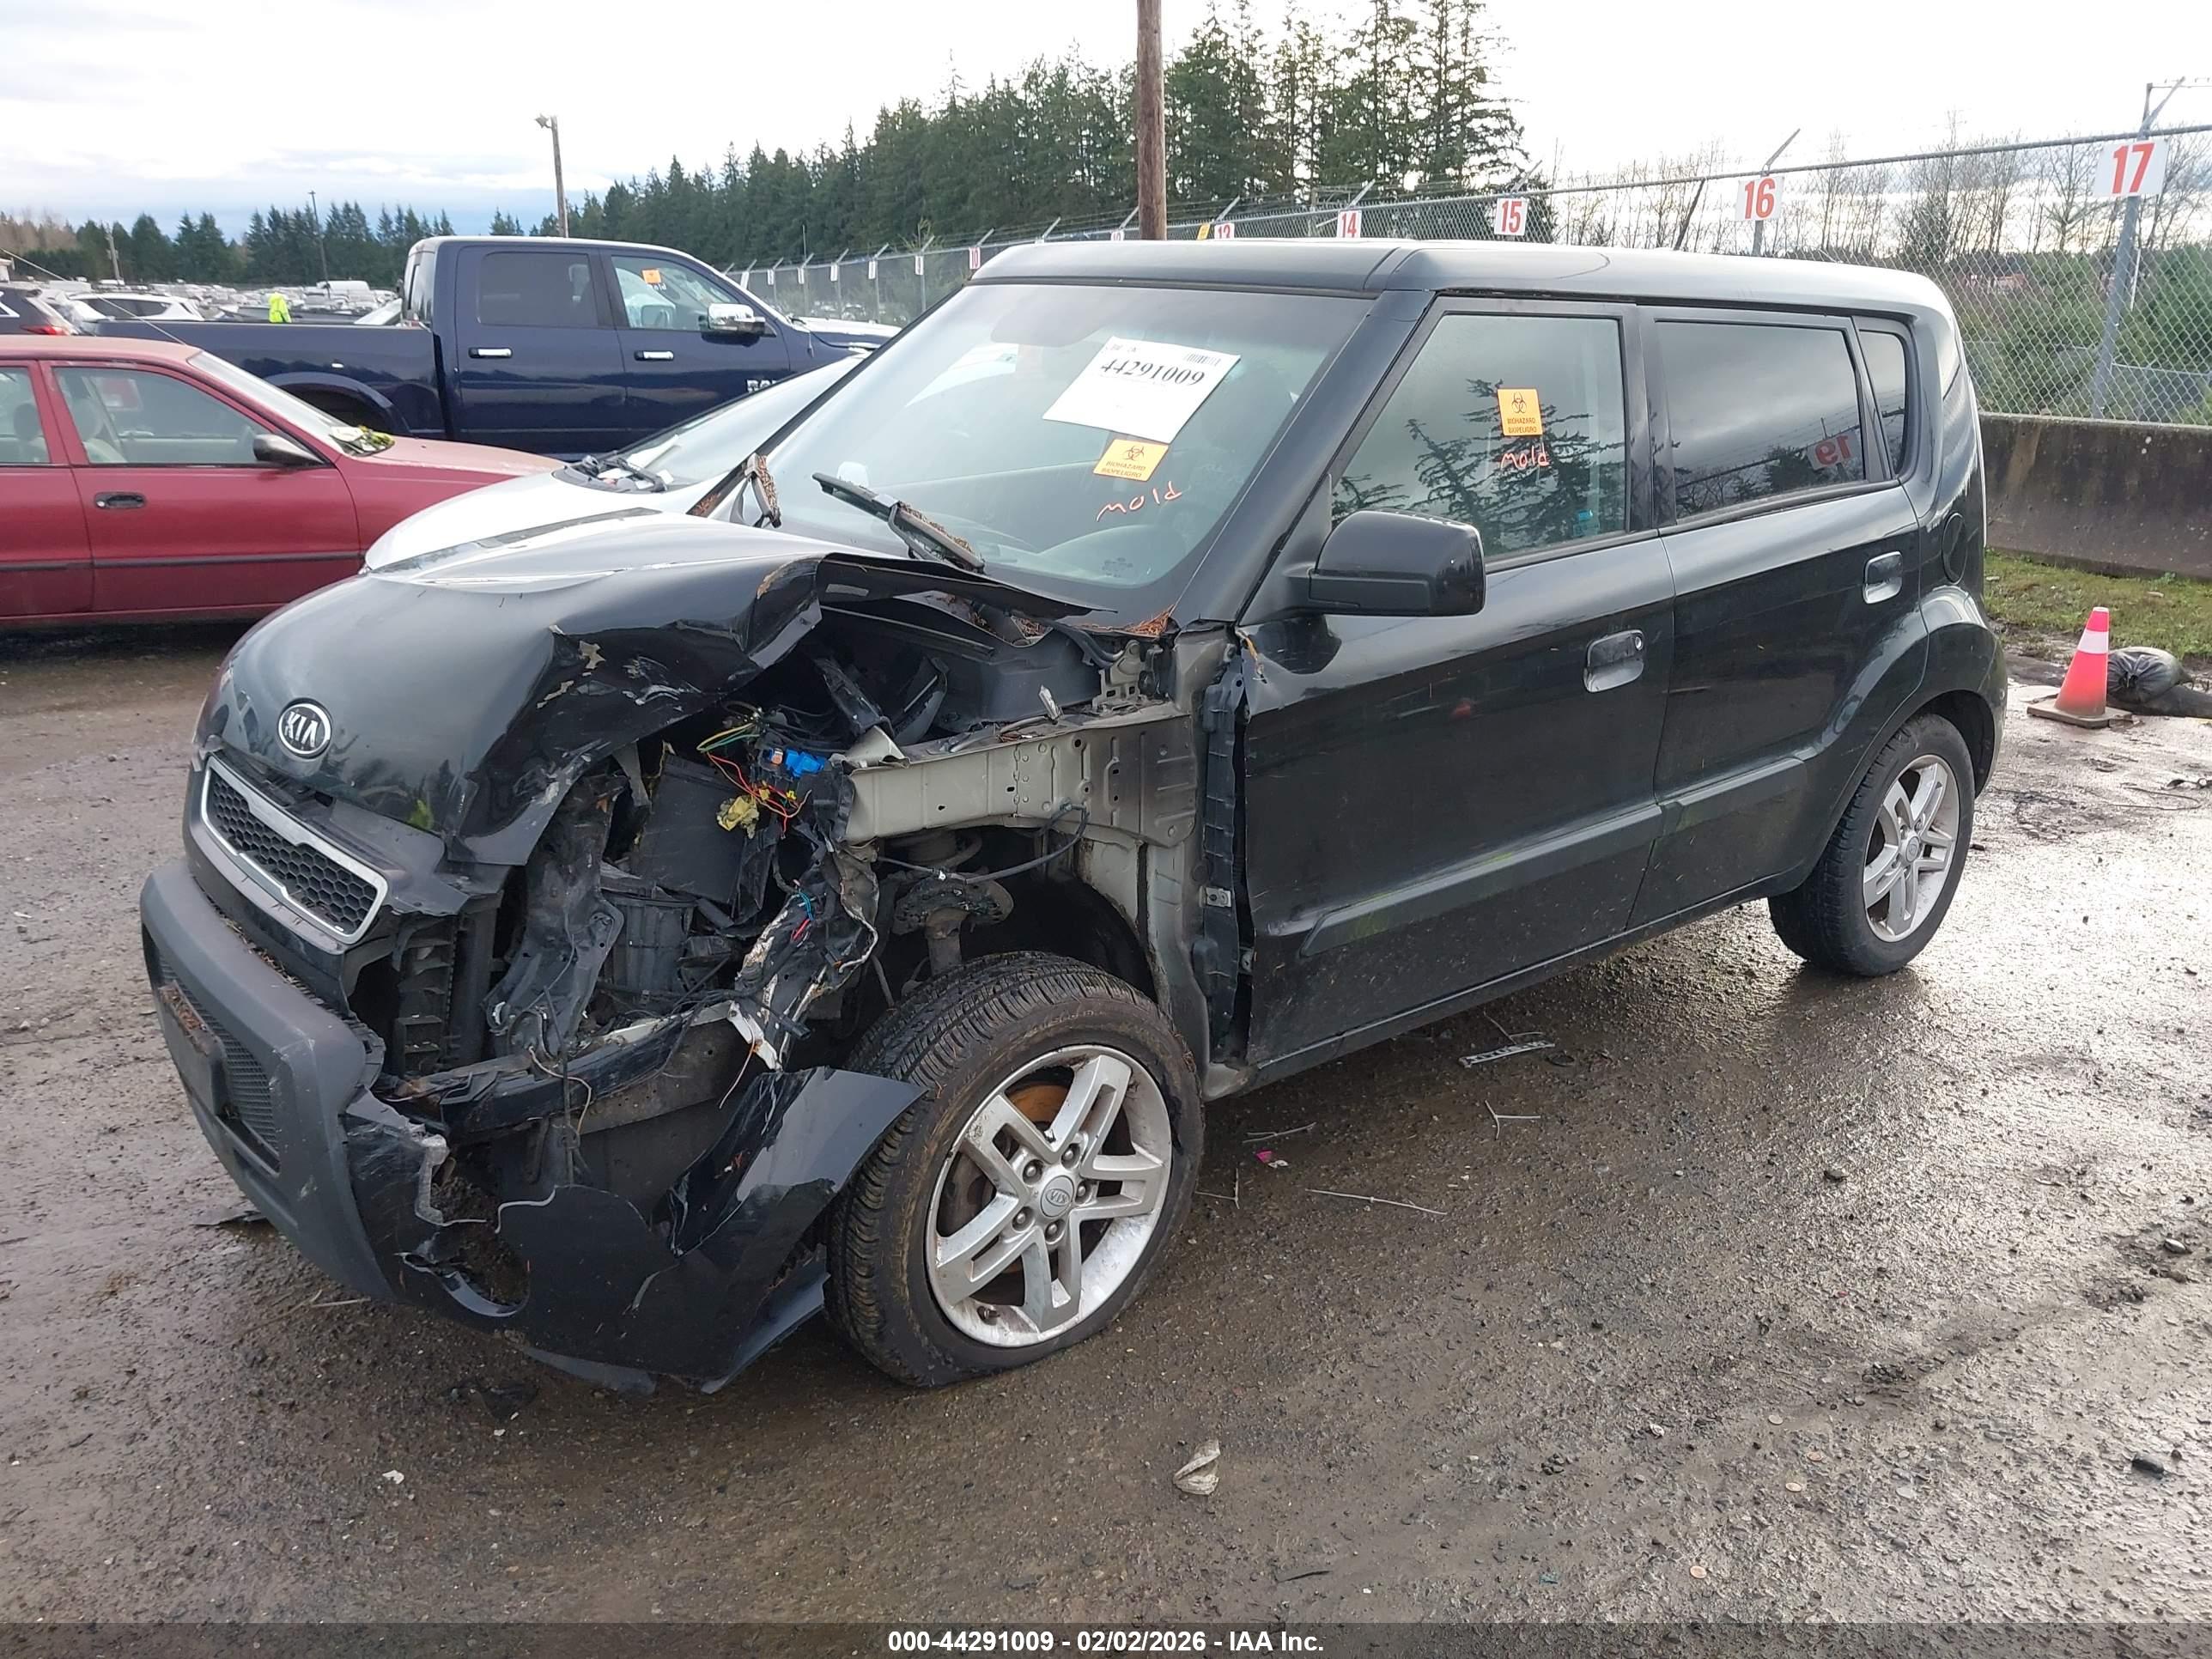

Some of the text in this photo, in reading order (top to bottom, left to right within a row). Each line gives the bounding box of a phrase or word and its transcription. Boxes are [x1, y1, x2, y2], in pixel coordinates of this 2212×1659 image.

[2112, 142, 2155, 195] 17
[1744, 177, 1776, 220] 16
[1341, 211, 1358, 238] 14
[1501, 200, 1522, 234] 15
[971, 249, 980, 268] 10
[1100, 357, 1206, 386] 44291009
[1105, 461, 1146, 472] BIOHAZARD
[284, 711, 319, 748] KIA
